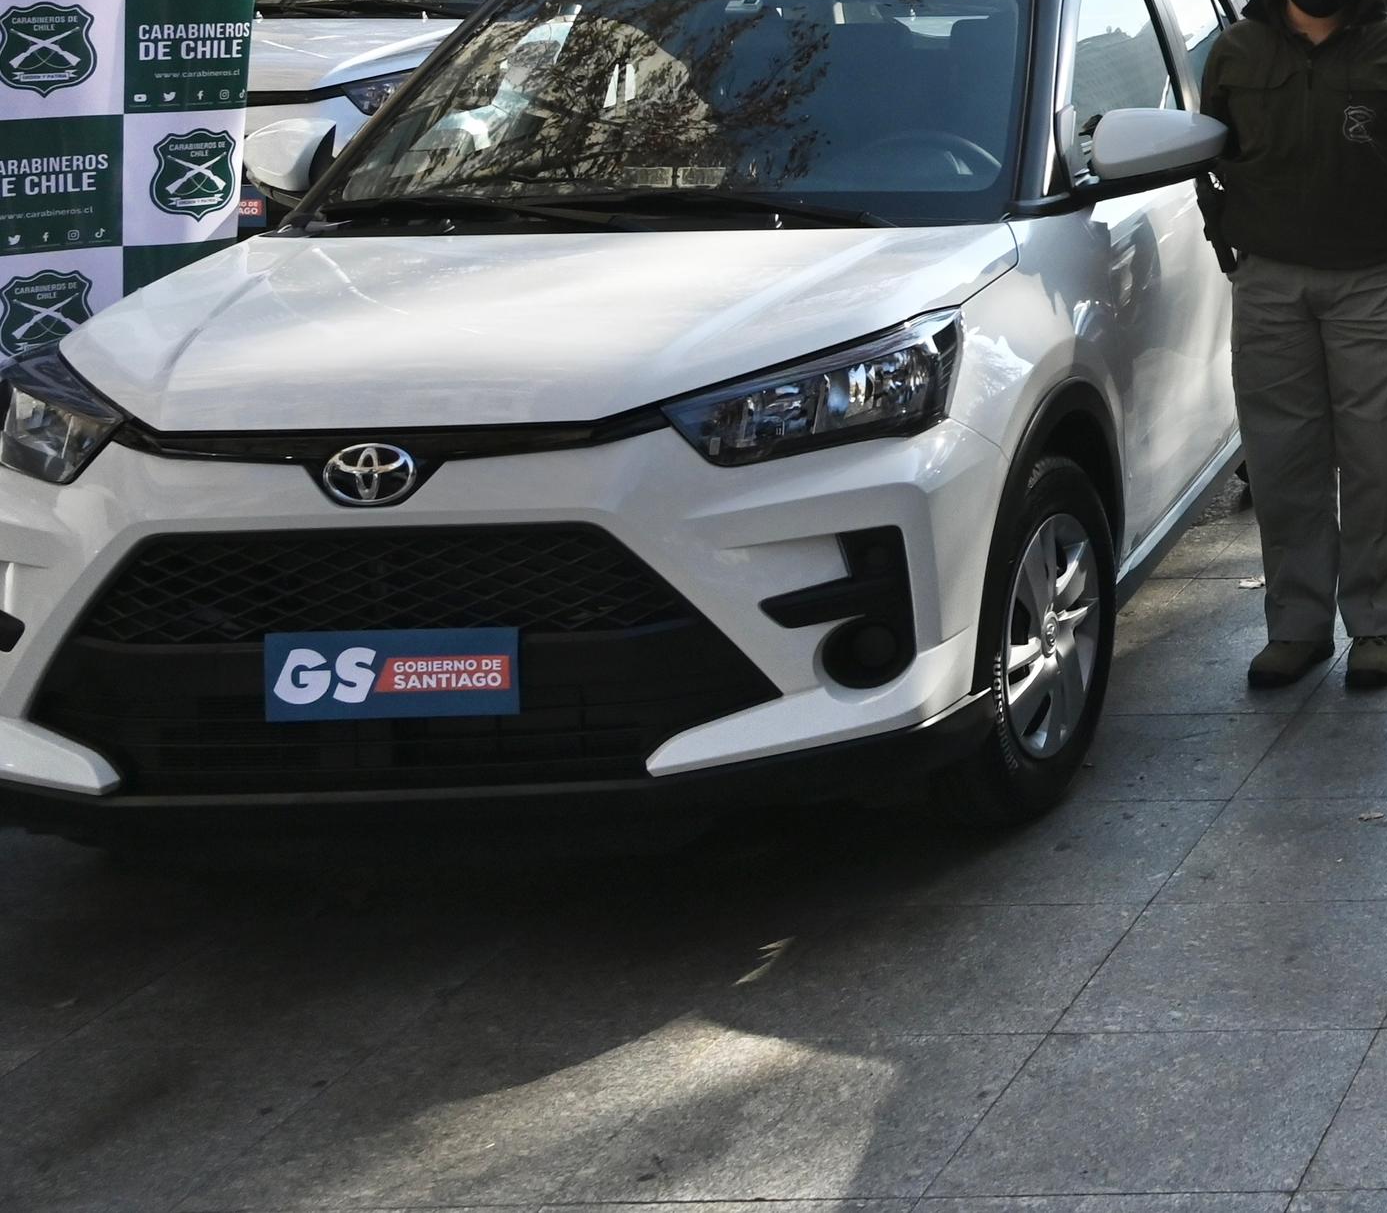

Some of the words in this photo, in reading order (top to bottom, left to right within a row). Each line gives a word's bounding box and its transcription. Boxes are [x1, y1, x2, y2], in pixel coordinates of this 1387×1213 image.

[11, 16, 65, 24] CARABINEROS
[138, 22, 250, 40] CARABINEROS
[139, 41, 172, 61] DE
[180, 39, 243, 60] CHILE
[154, 69, 240, 79] www.carabineros.cl
[24, 172, 97, 196] CHILE
[273, 646, 376, 705] GS
[393, 660, 477, 674] GOBIERNO
[481, 659, 501, 671] DE
[393, 672, 502, 690] SANTIAGO
